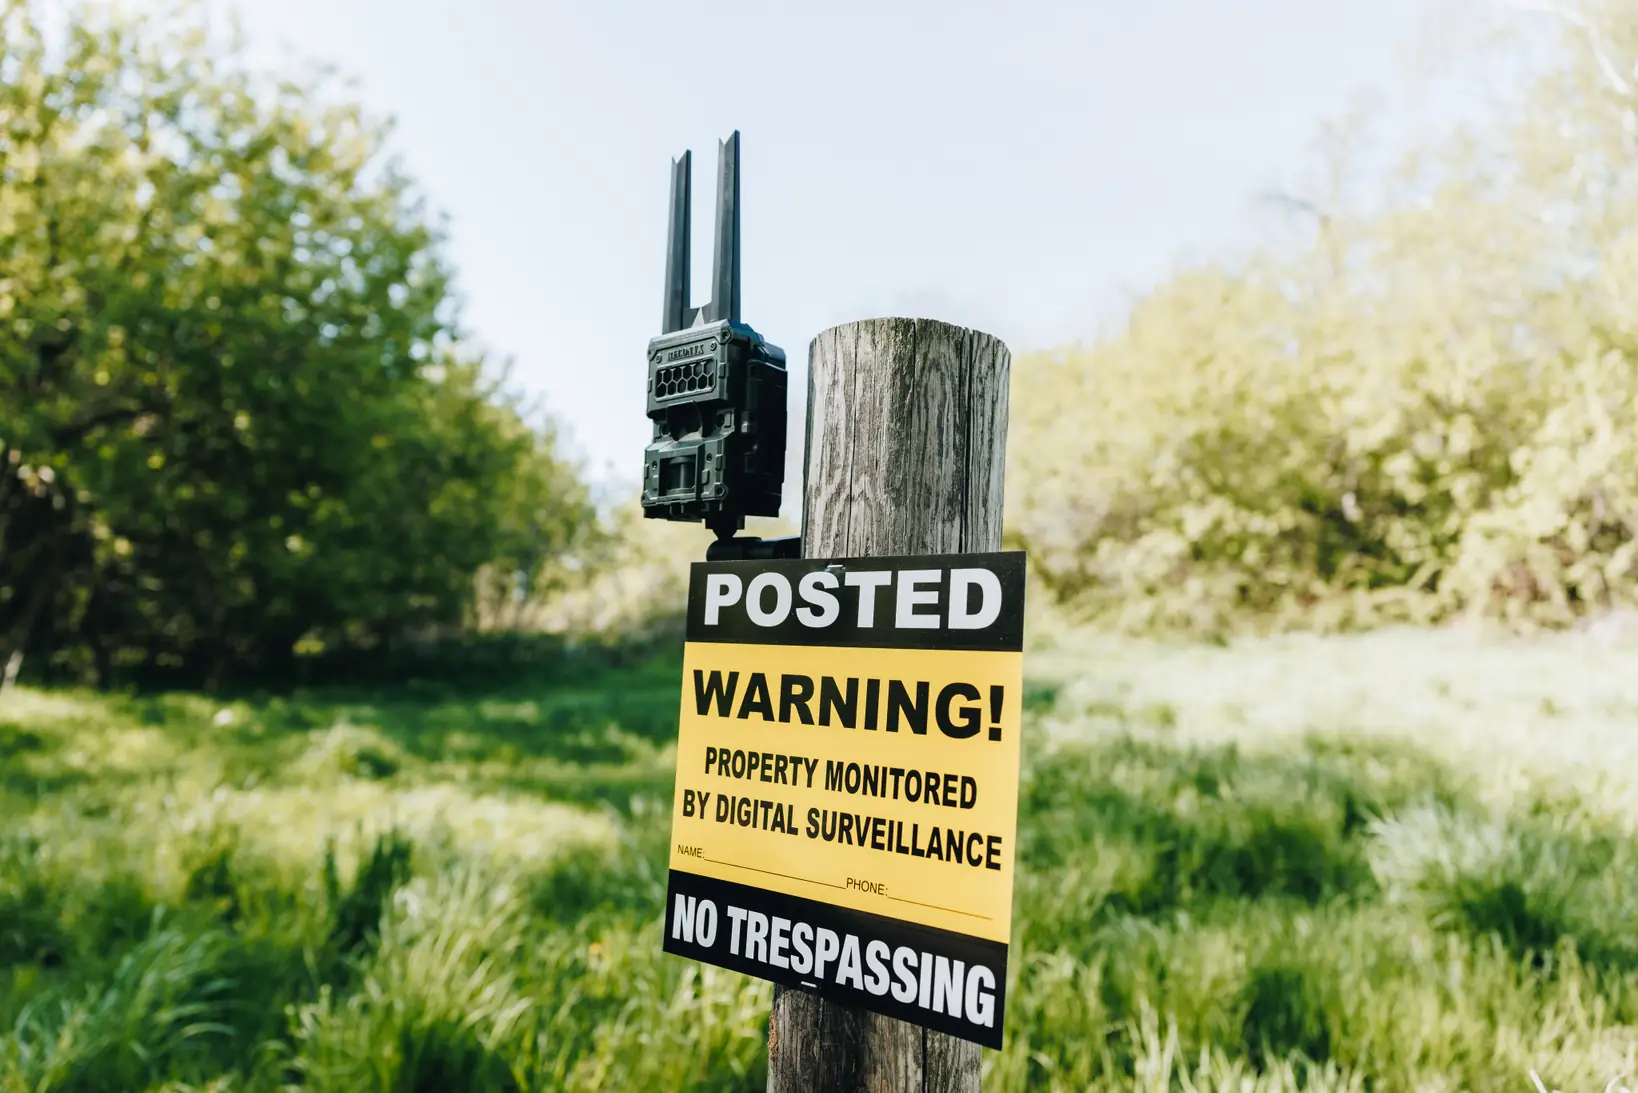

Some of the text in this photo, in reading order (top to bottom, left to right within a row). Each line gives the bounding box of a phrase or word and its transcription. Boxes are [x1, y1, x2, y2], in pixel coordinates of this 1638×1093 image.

[703, 567, 1003, 630] POSTED
[693, 669, 1005, 742] WARNING!
[704, 746, 978, 811] PROPERTY MONITORED
[682, 788, 1003, 871] BY DIGITAL SURVEILLANCE
[677, 844, 889, 897] NAME: PHONE:
[671, 893, 997, 1029] NO TRESPASSING
